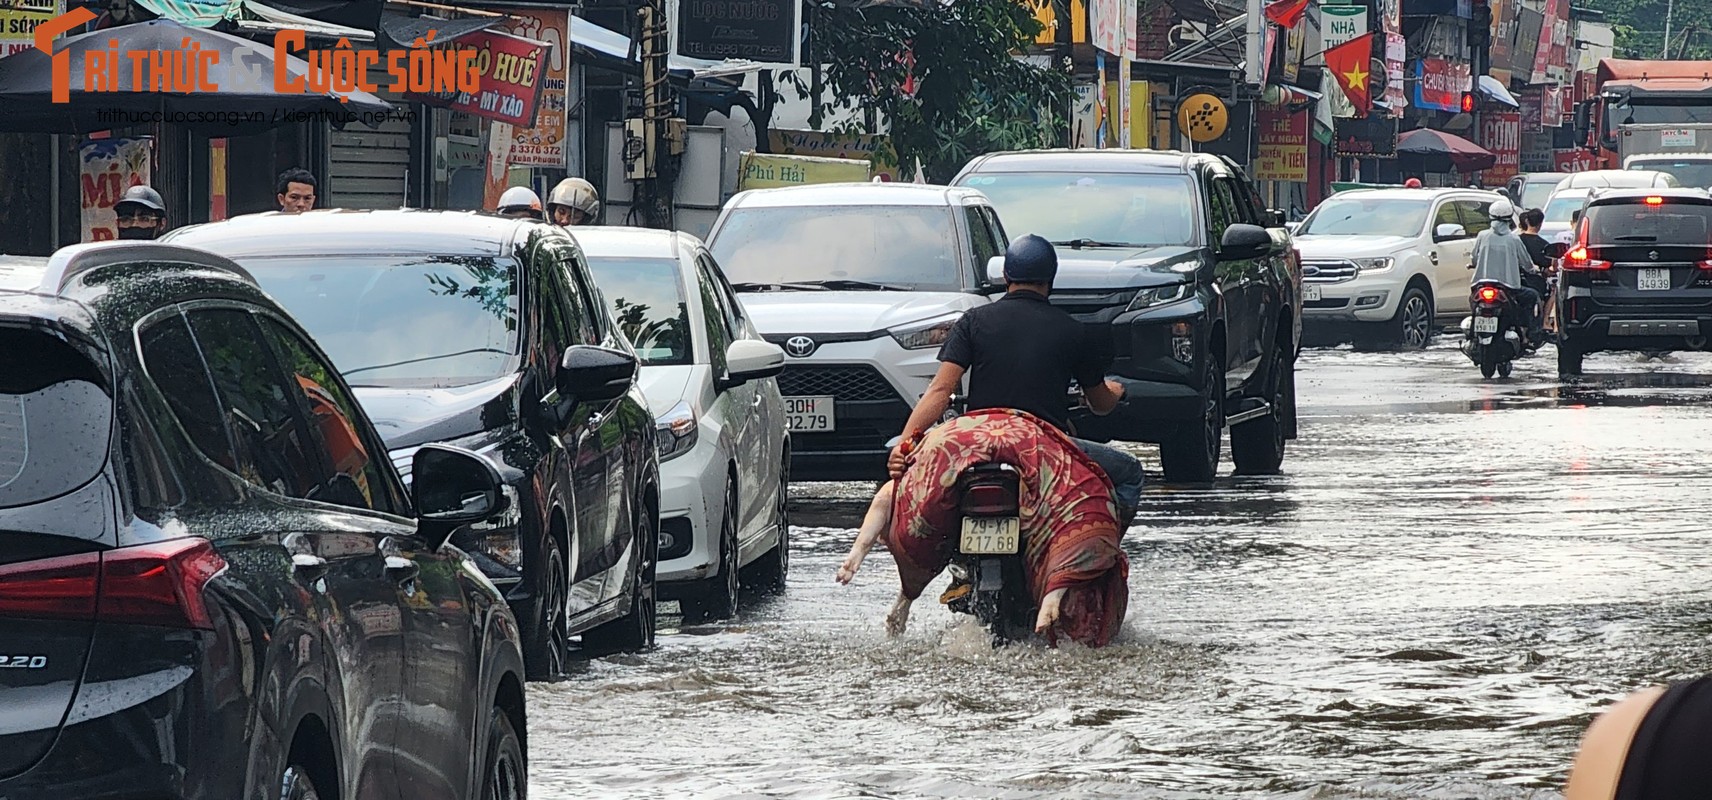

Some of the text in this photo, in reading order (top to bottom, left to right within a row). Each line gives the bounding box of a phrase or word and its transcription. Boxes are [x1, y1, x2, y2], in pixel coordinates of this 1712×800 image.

[9, 16, 49, 34] SÓN
[1331, 18, 1356, 34] NHÀ
[493, 47, 541, 88] HUẾ
[480, 90, 499, 111] MỲ
[500, 94, 524, 118] XÀO
[1484, 119, 1518, 151] CƠM
[543, 146, 560, 155] 372
[746, 163, 805, 182] Phú Hải
[785, 399, 815, 414] 30H
[970, 519, 1010, 535] 29-X1
[965, 536, 1014, 551] 217.68
